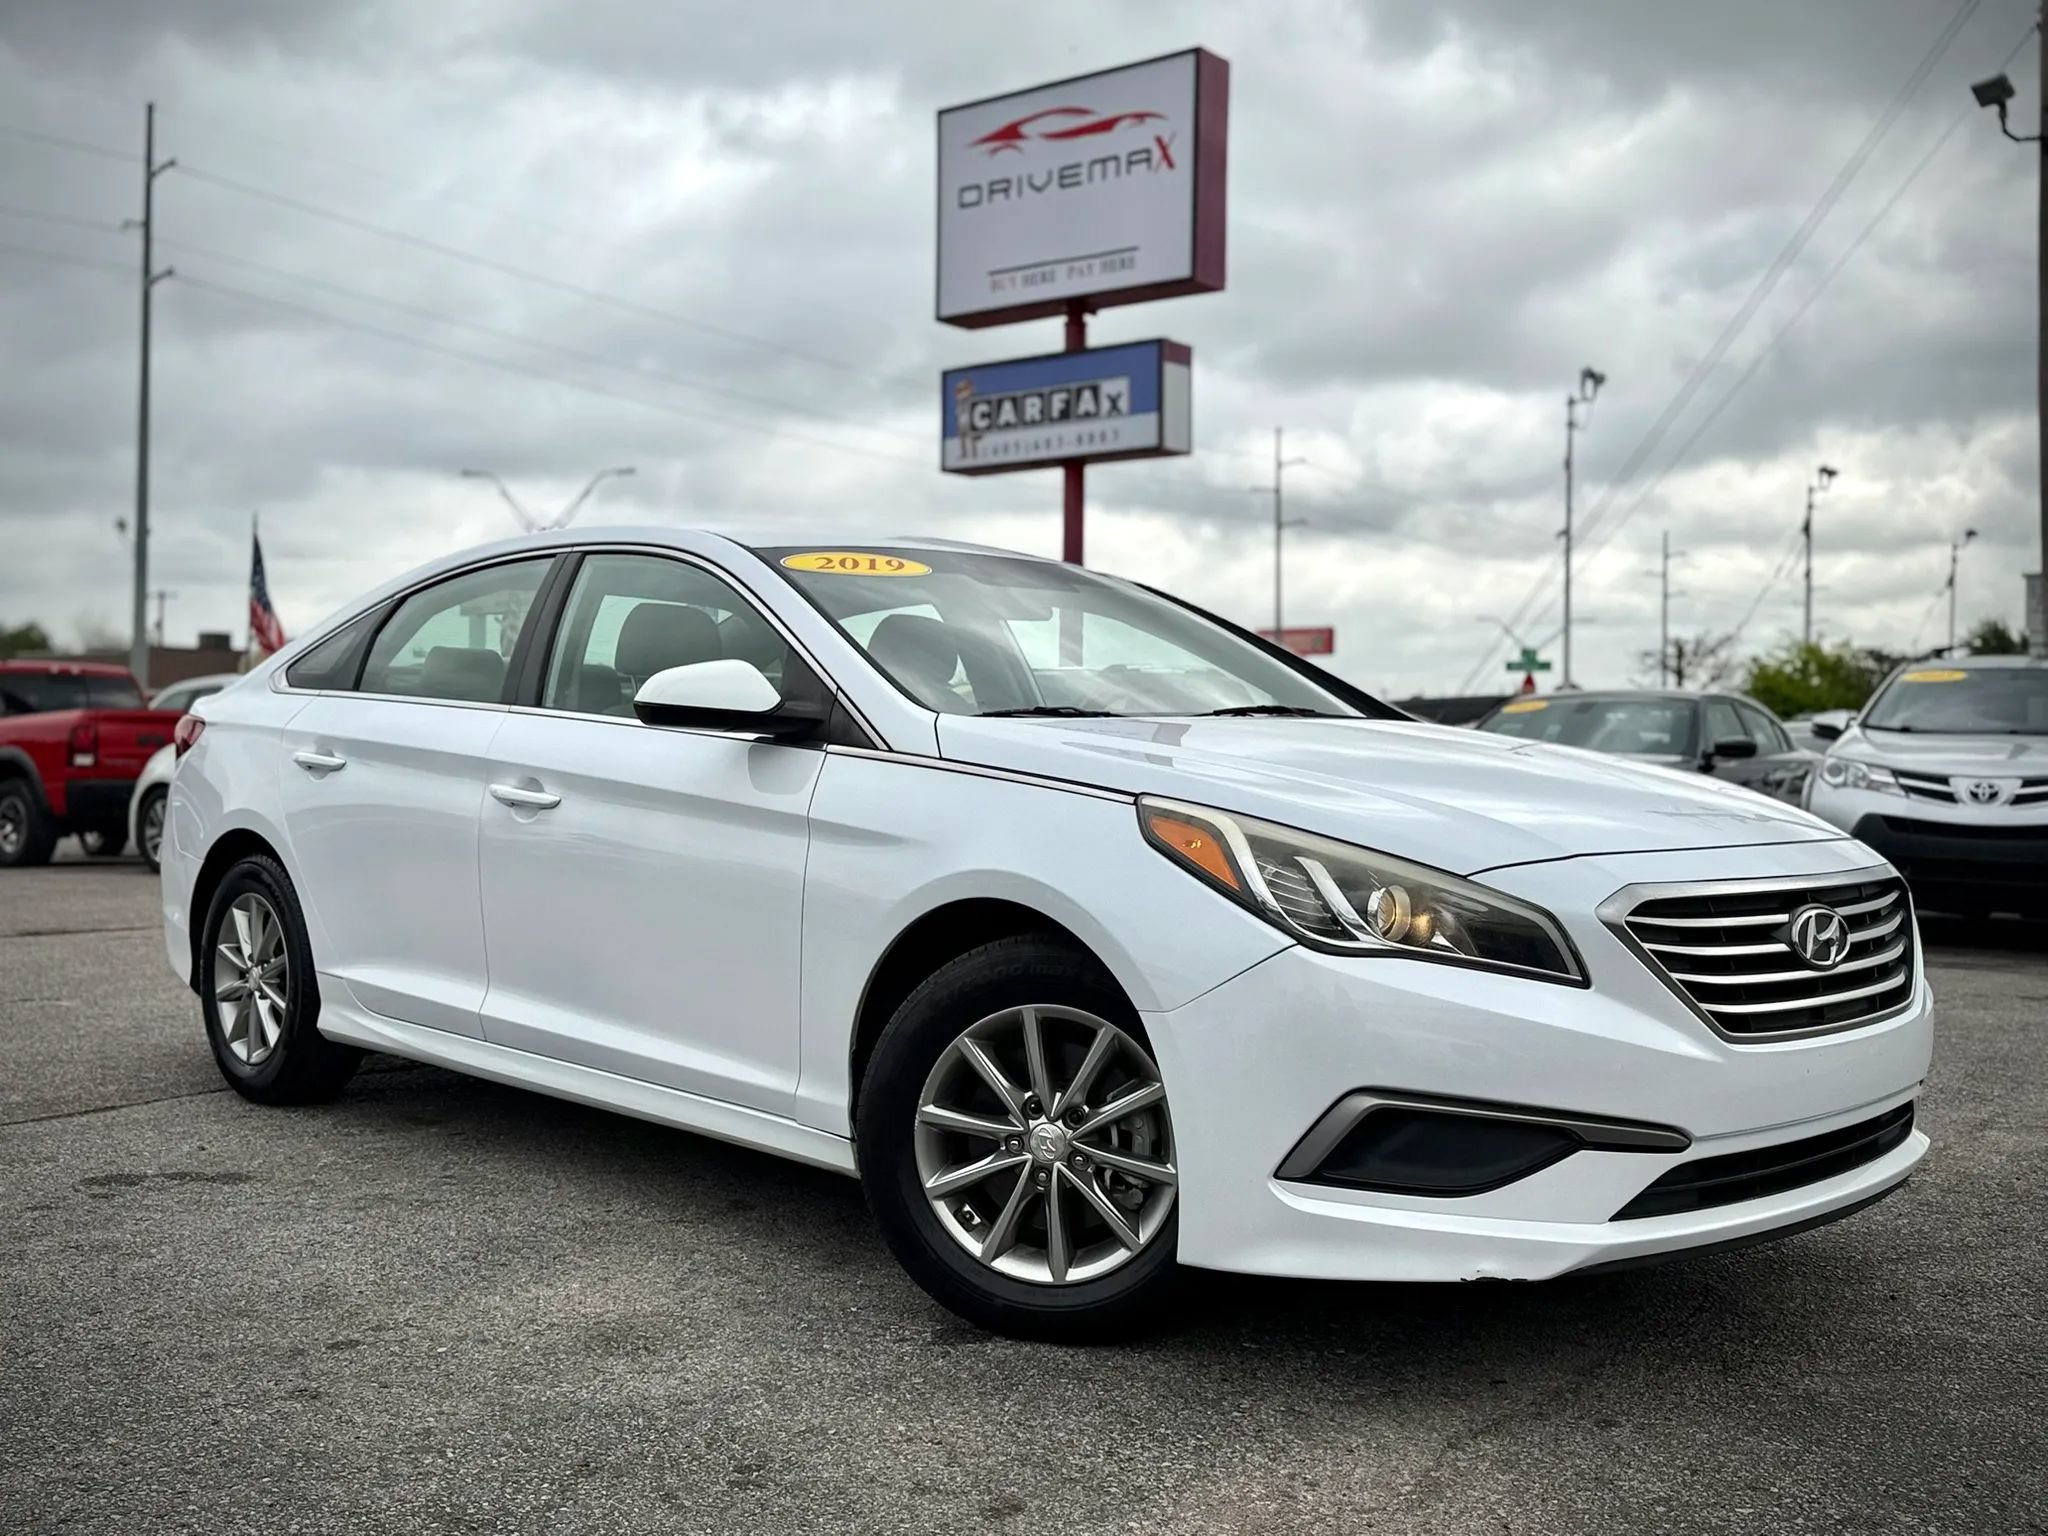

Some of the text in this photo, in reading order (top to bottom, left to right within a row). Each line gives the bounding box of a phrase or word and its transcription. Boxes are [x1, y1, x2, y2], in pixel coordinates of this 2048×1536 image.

[958, 134, 1176, 209] DRIVEMAX
[971, 387, 1126, 430] CARFAX
[815, 557, 906, 571] 2019
